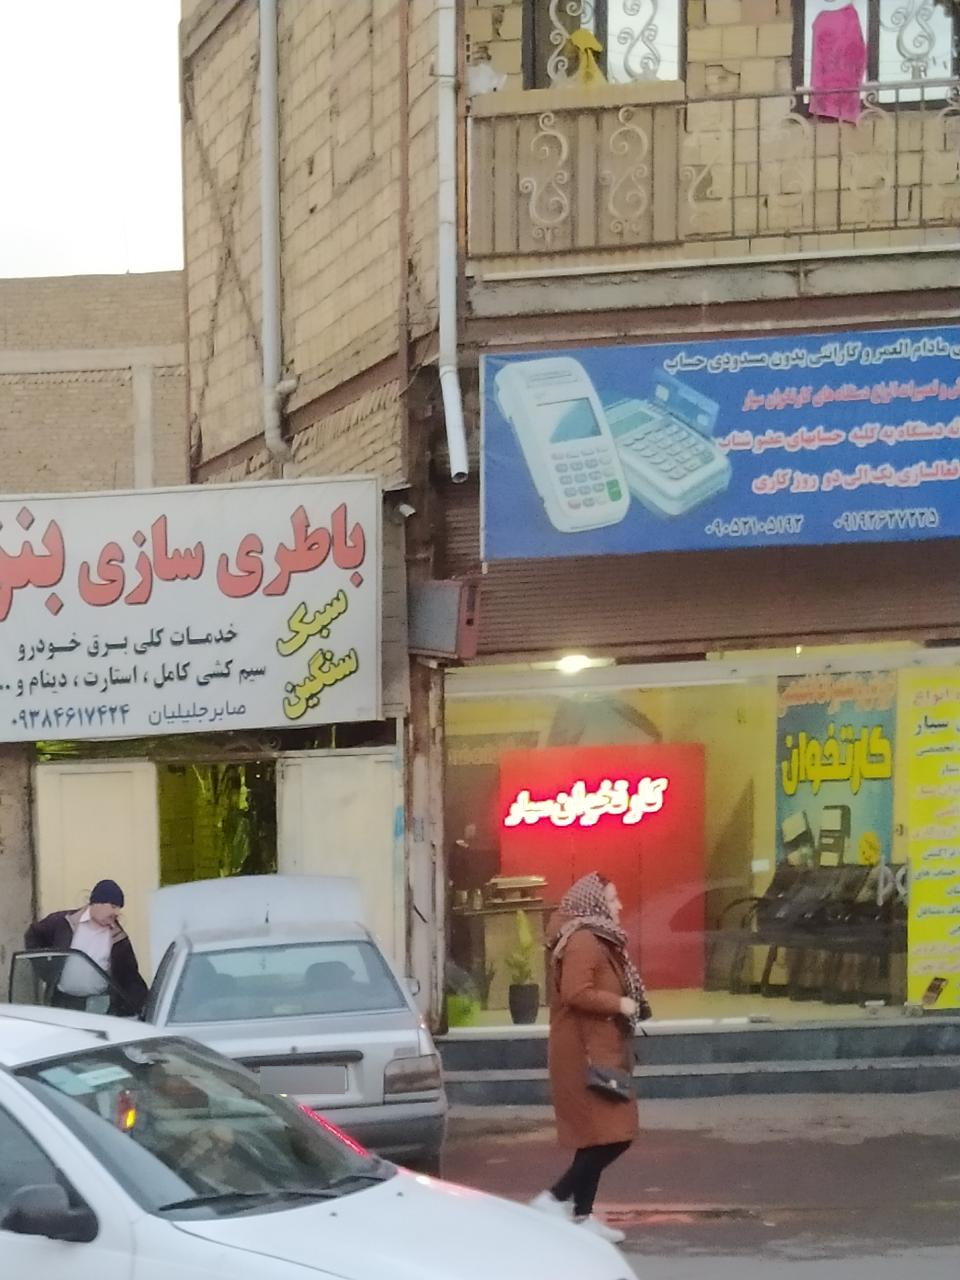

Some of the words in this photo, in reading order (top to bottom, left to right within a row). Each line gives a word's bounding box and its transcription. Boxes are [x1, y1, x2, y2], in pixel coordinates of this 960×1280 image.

[663, 351, 708, 375] حساب
[707, 351, 769, 374] مسدودی
[768, 348, 808, 370] بدون
[860, 346, 872, 365] و
[784, 425, 846, 453] حسابهای
[847, 422, 880, 448] کلیه
[751, 467, 793, 495] کاری
[791, 470, 820, 493] روز
[820, 470, 842, 492] دو
[78, 514, 205, 606] سازی
[216, 502, 366, 598] باطری
[170, 623, 238, 646] خدمات
[276, 588, 349, 657] سبک
[17, 632, 81, 661] خودرو
[86, 635, 128, 657] برق
[133, 627, 164, 654] کلی
[29, 669, 68, 694] دینام
[196, 659, 234, 686] کشی
[239, 665, 266, 684] سیم
[282, 648, 360, 720] سنگین
[15, 680, 25, 697] و
[148, 702, 209, 726] جلیلیان
[208, 700, 247, 722] صابر
[781, 721, 893, 797] کارتخوان
